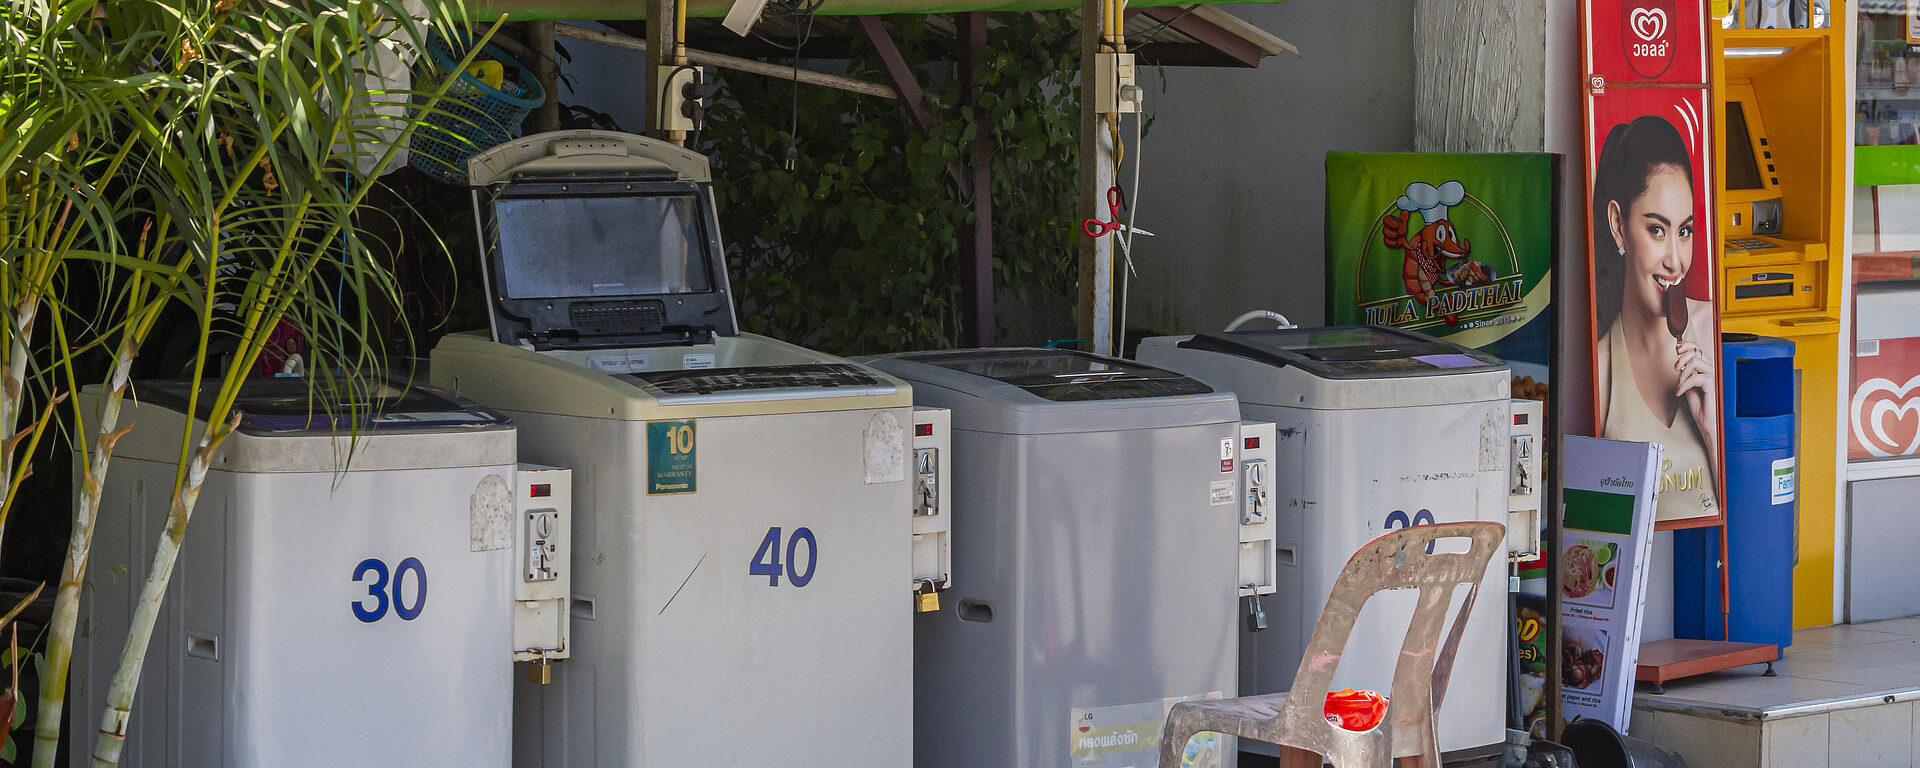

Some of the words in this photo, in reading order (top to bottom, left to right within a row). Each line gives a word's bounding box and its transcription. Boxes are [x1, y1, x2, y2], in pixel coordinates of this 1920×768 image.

[1633, 40, 1666, 57] วอลล์
[1425, 279, 1523, 318] PADTHAI
[1474, 319, 1493, 328] Since
[666, 425, 694, 455] 10
[749, 527, 818, 588] 40
[351, 556, 427, 623] 30
[1084, 712, 1093, 720] LG
